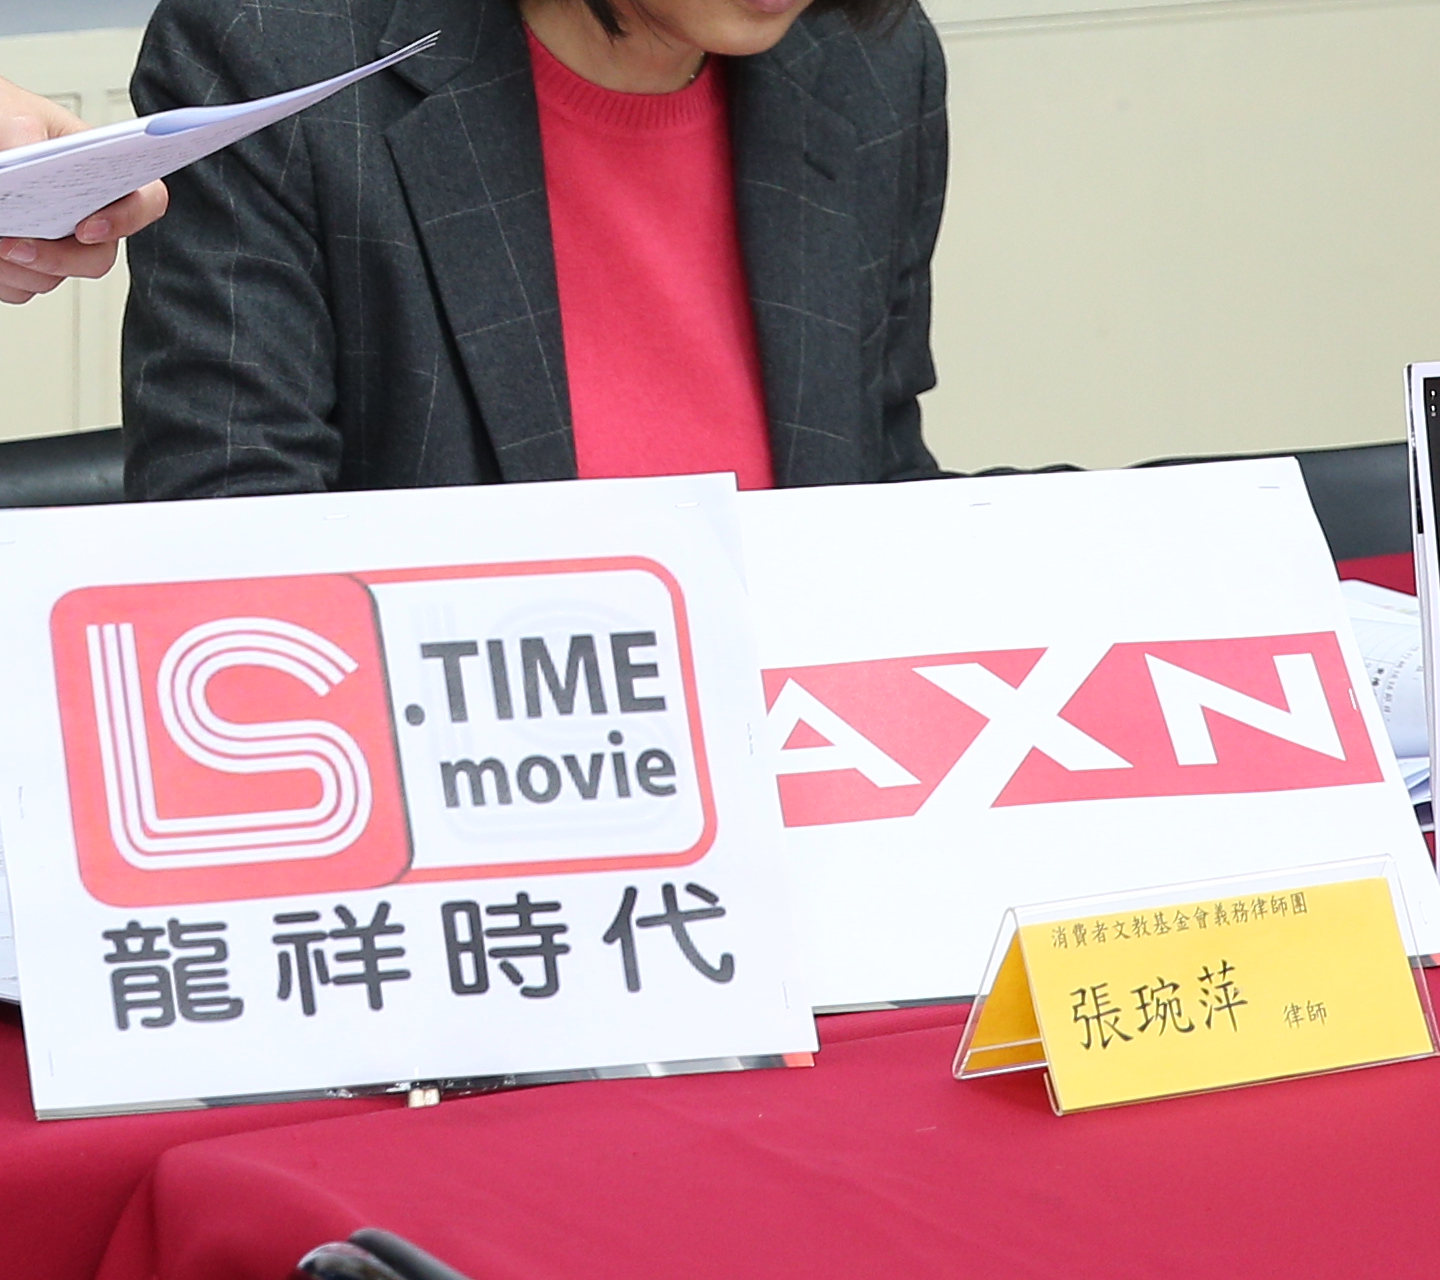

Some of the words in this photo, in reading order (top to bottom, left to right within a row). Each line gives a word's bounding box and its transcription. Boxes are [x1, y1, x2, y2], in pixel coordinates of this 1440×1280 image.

[439, 730, 678, 808] movie
[764, 643, 1345, 811] AXN
[101, 883, 736, 1032] 龍祥時代
[1070, 959, 1249, 1051] 張琬萍
[1282, 999, 1329, 1029] 律師
